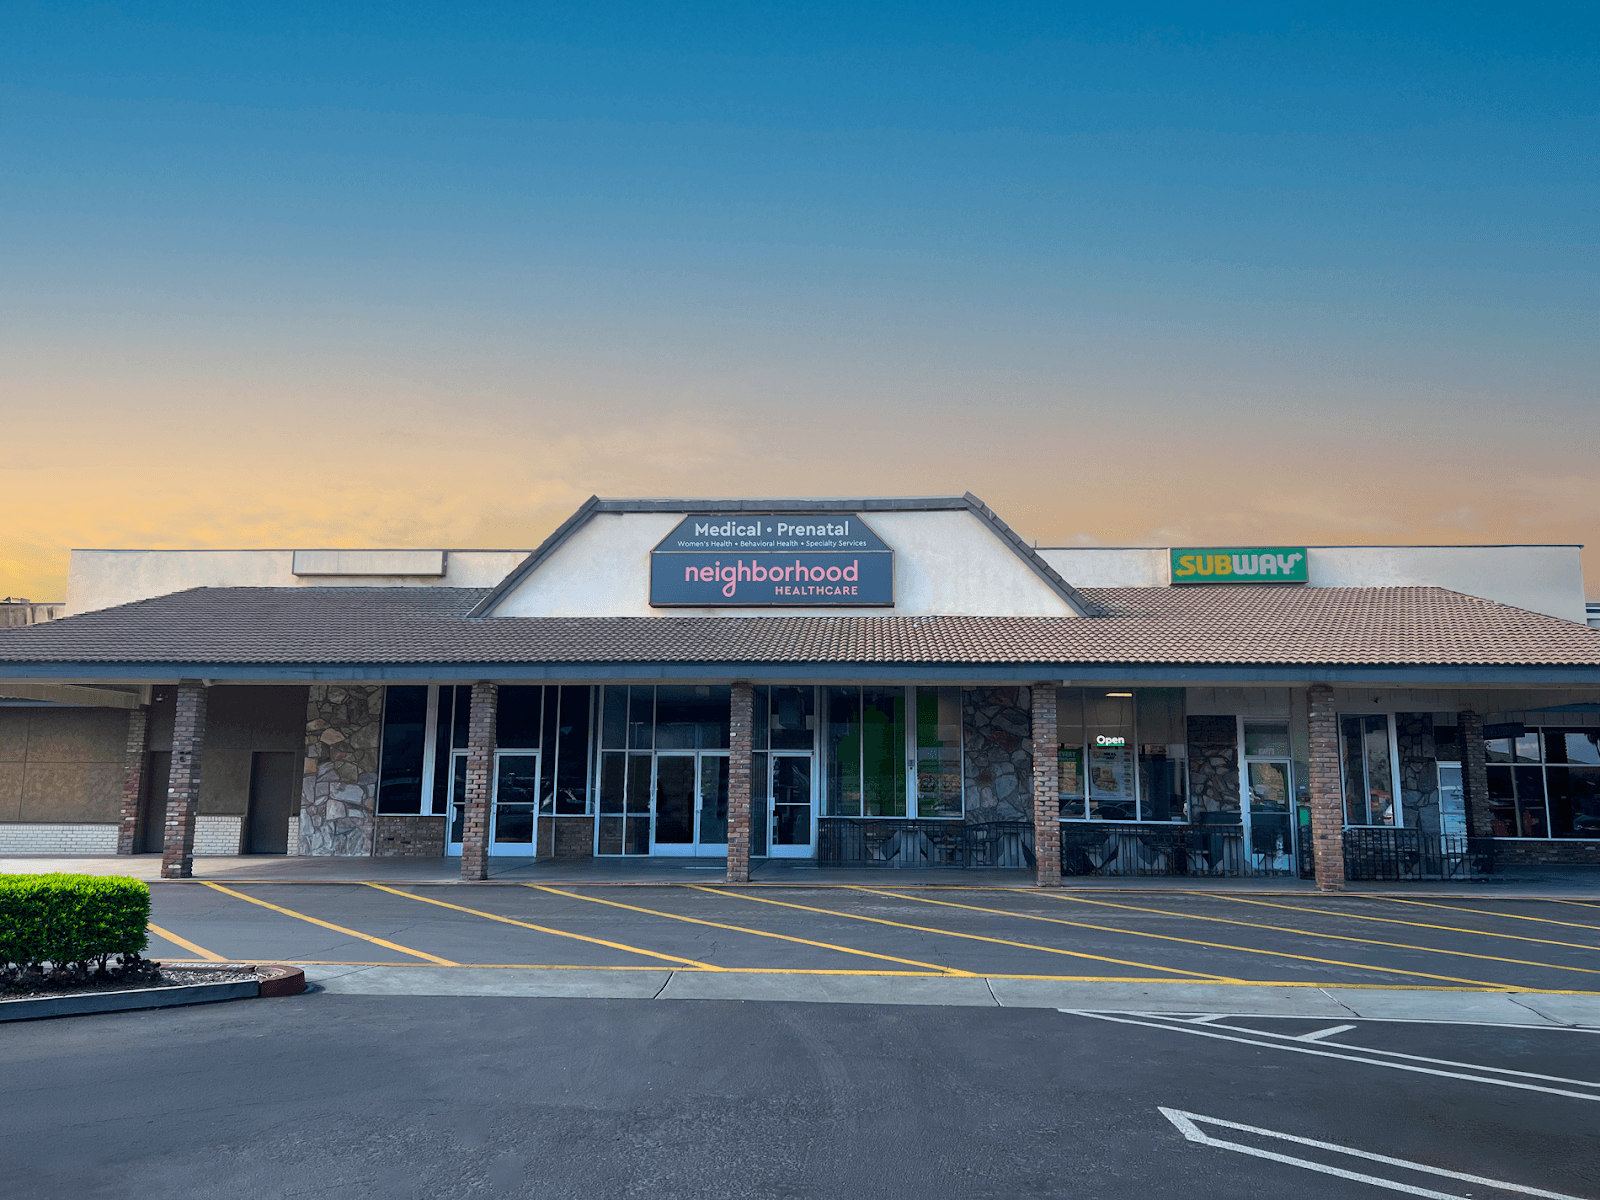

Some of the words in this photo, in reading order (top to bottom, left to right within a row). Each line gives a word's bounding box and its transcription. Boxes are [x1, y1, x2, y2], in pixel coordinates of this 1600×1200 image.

[695, 521, 761, 536] Medical
[777, 520, 849, 536] Prenatal
[806, 540, 837, 548] Specialty
[1175, 552, 1303, 577] SUBWAY
[685, 560, 858, 597] neighborhood
[775, 586, 858, 595] HEALTHCARE
[1096, 734, 1125, 746] Open
